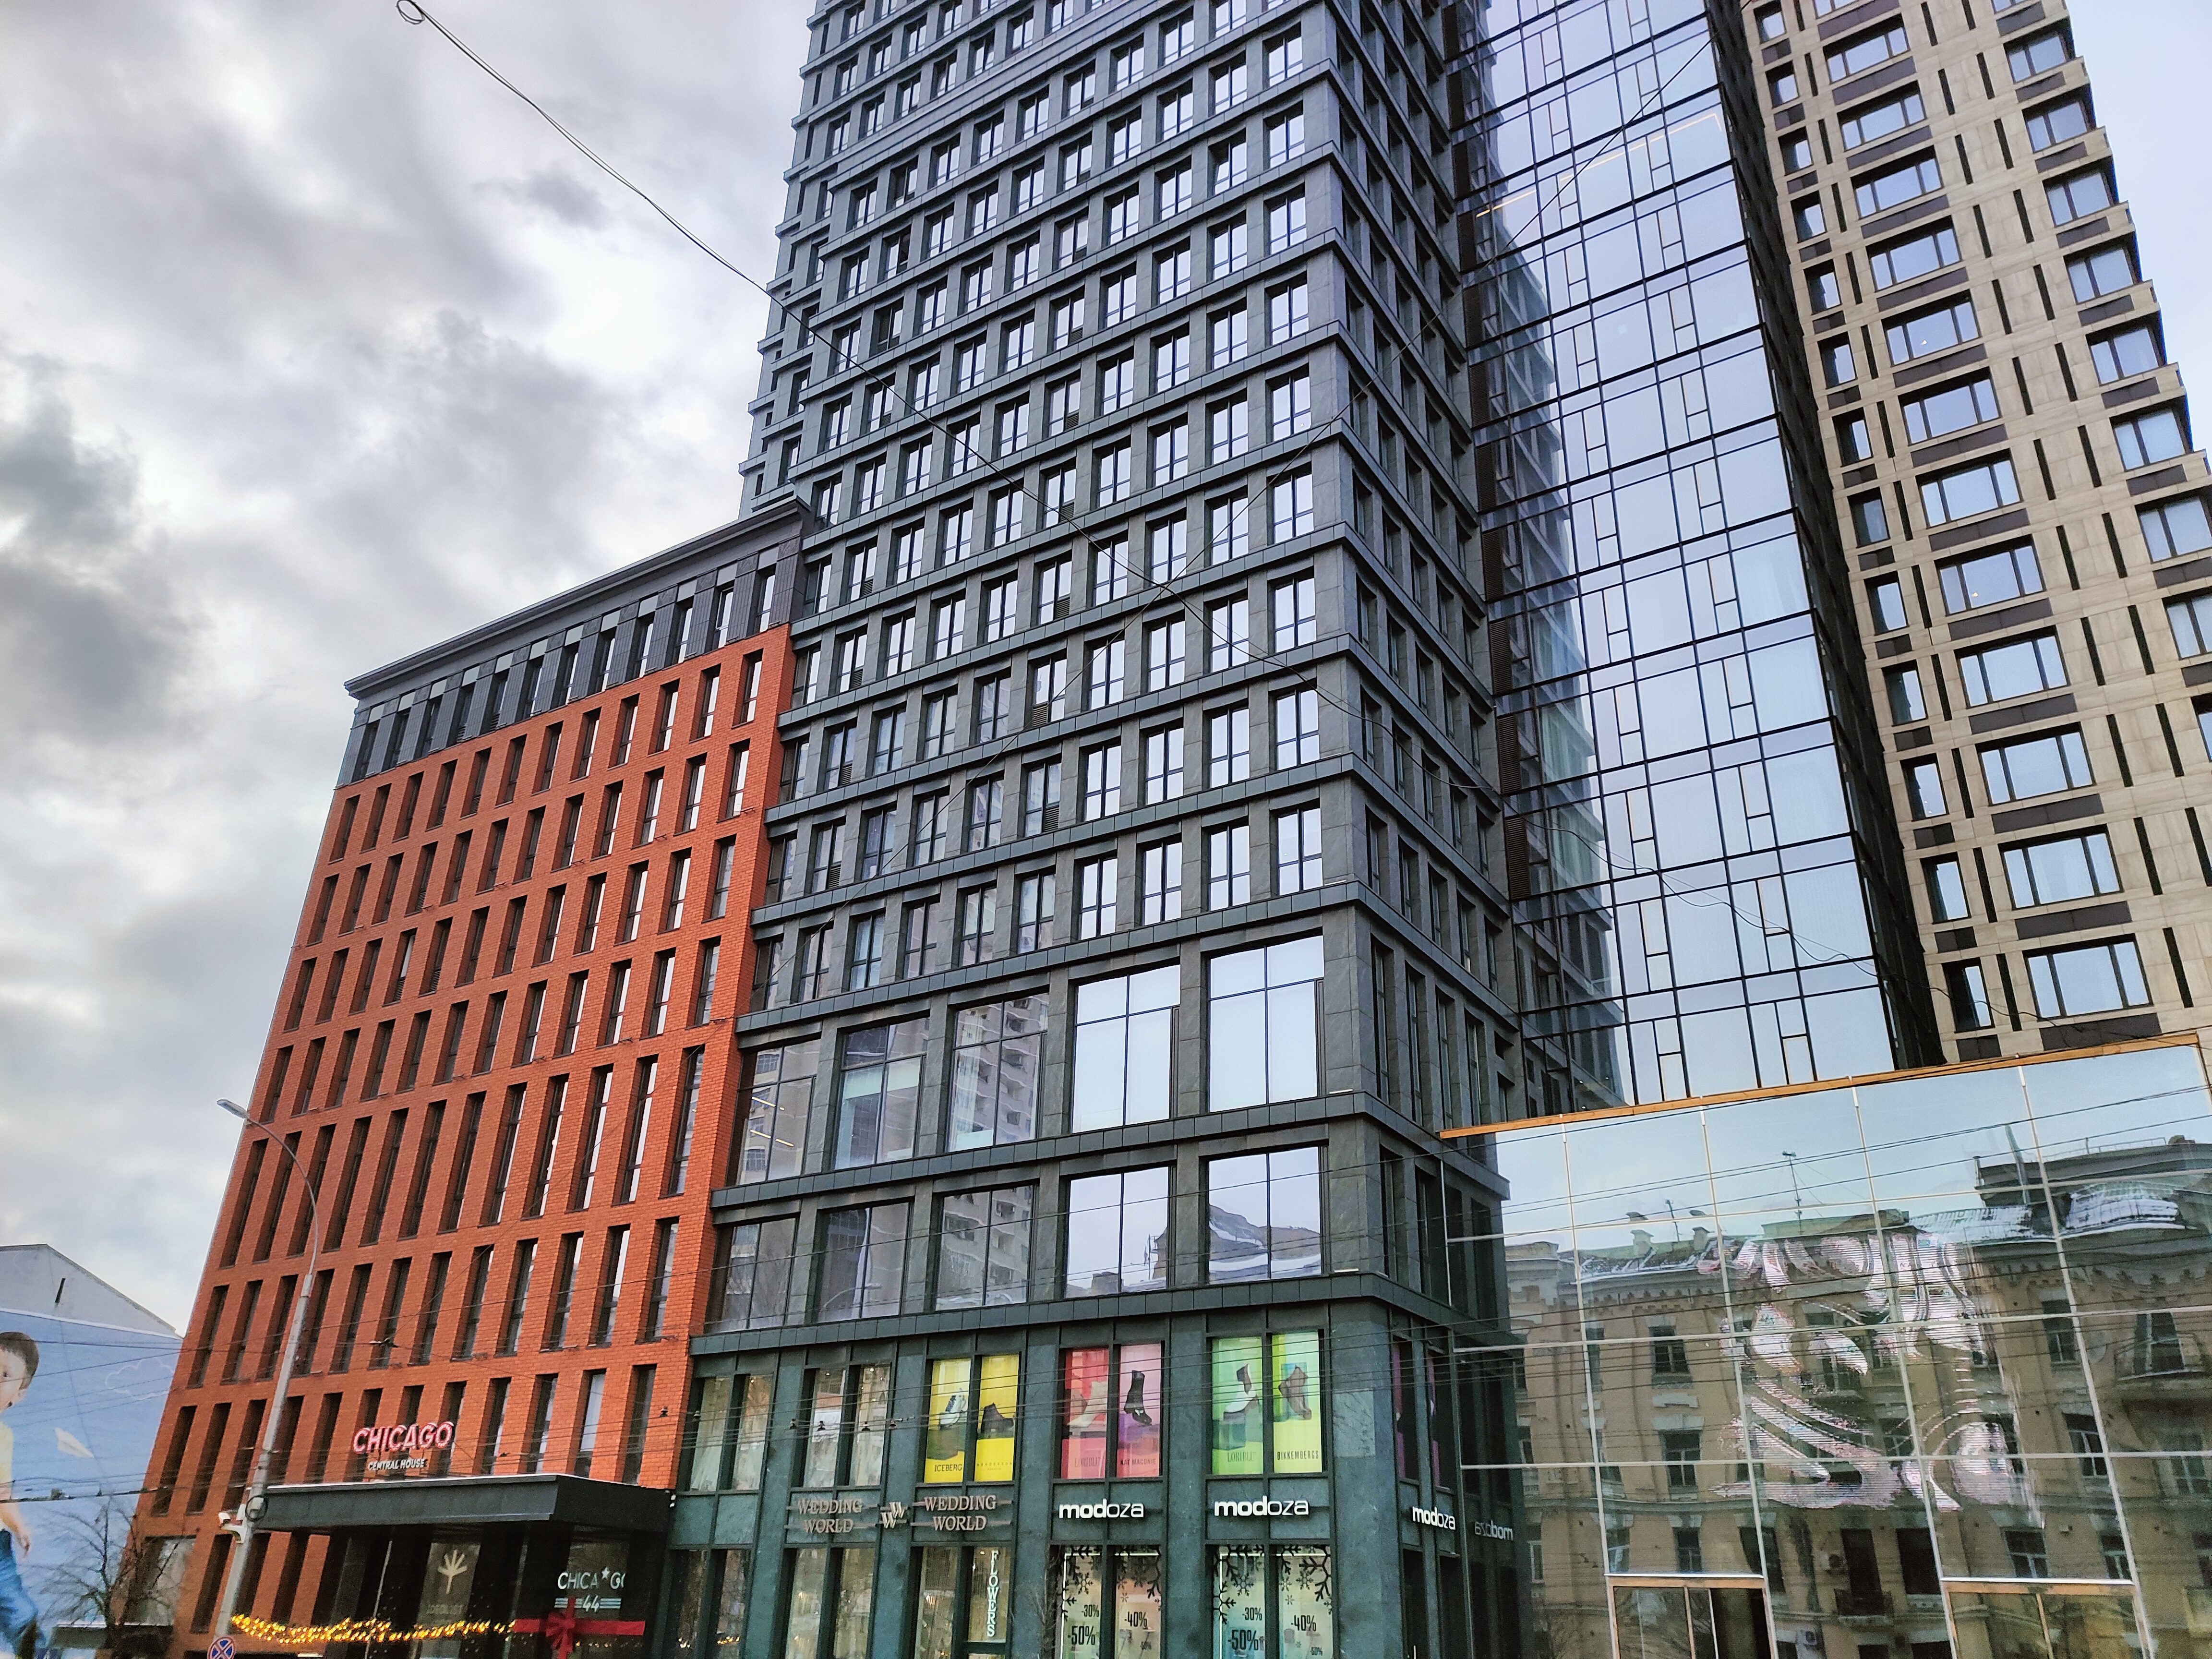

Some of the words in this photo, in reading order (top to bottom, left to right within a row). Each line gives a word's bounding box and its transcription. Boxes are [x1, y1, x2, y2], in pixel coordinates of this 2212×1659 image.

[353, 1421, 454, 1454] CHICAGO
[1277, 1450, 1319, 1461] BIKKEMBERGS
[367, 1460, 399, 1471] CENTRAL
[400, 1458, 425, 1469] HOUSE
[797, 1497, 863, 1515] WEDDING
[924, 1495, 997, 1511] WEDDING
[1059, 1498, 1144, 1519] modoza
[1214, 1495, 1309, 1516] modoza
[804, 1518, 854, 1534] WORLD
[933, 1515, 987, 1531] WORLD
[1412, 1506, 1456, 1530] modoza
[987, 1550, 999, 1637] FLOWERS
[582, 1594, 599, 1612] 44
[1082, 1604, 1099, 1617] -30%
[1124, 1611, 1147, 1627] -40%
[1242, 1607, 1262, 1621] -30%
[1291, 1615, 1316, 1632] -40%
[1068, 1625, 1095, 1645] -50%
[1228, 1630, 1259, 1650] -50%
